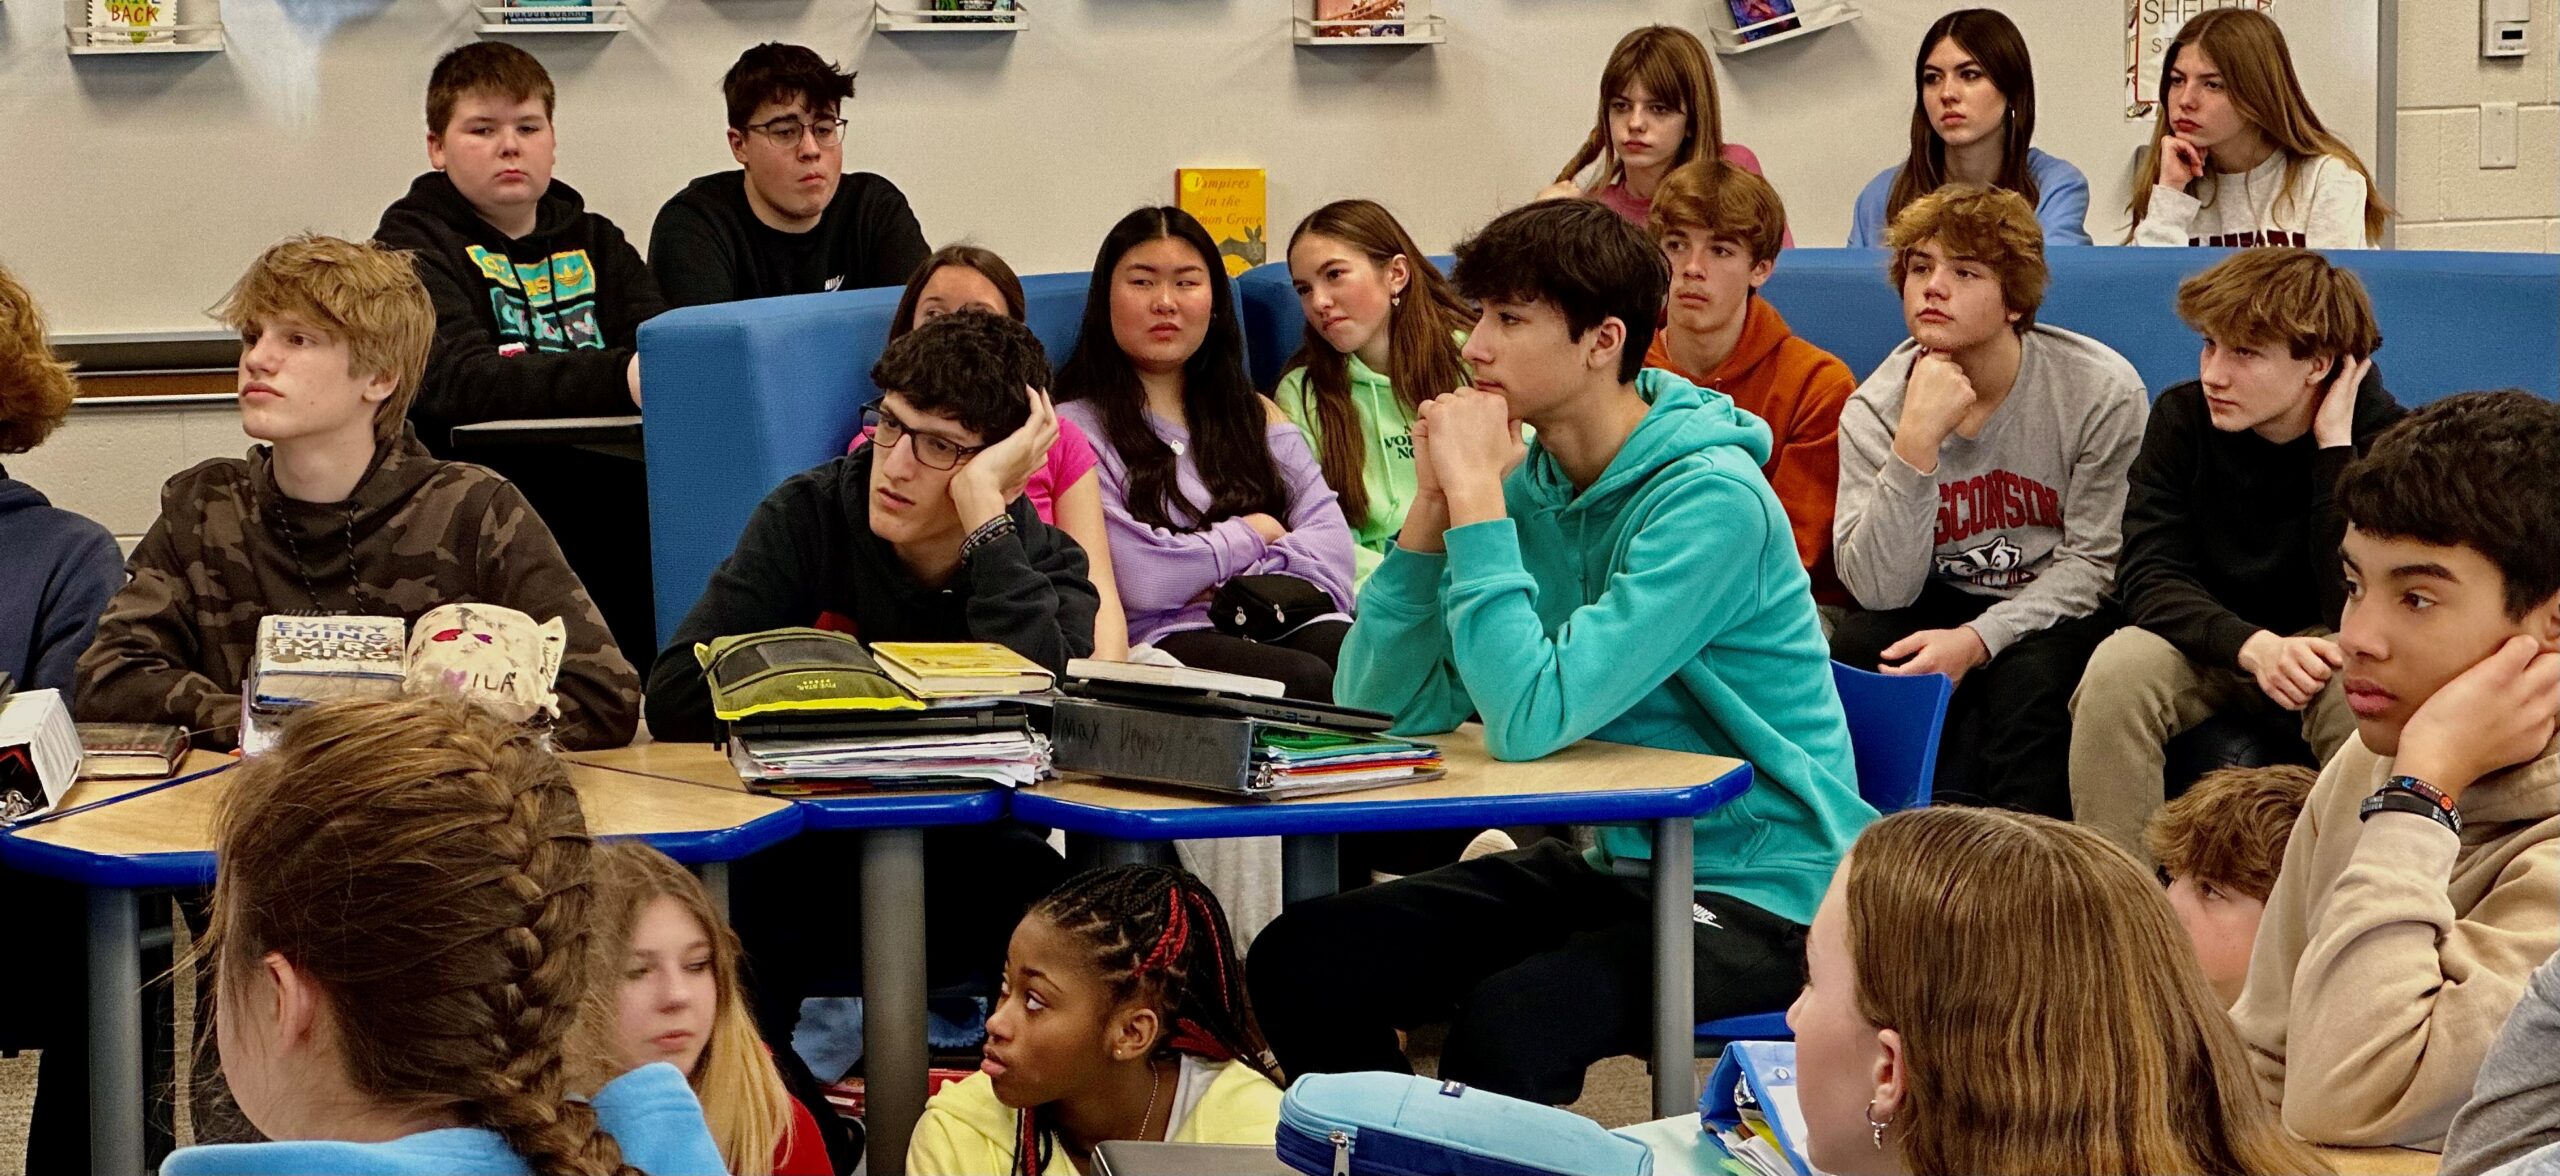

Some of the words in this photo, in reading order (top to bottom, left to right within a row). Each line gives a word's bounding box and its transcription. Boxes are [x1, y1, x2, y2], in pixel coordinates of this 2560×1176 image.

[111, 4, 158, 23] BACK
[1194, 176, 1251, 191] Vampires
[1204, 195, 1218, 207] in
[1222, 194, 1241, 207] the
[1226, 213, 1263, 225] Grove
[276, 621, 386, 633] EVERY
[276, 627, 388, 641] THING
[275, 638, 389, 650] EVERY
[278, 646, 389, 660] THING
[1060, 716, 1100, 750] Max
